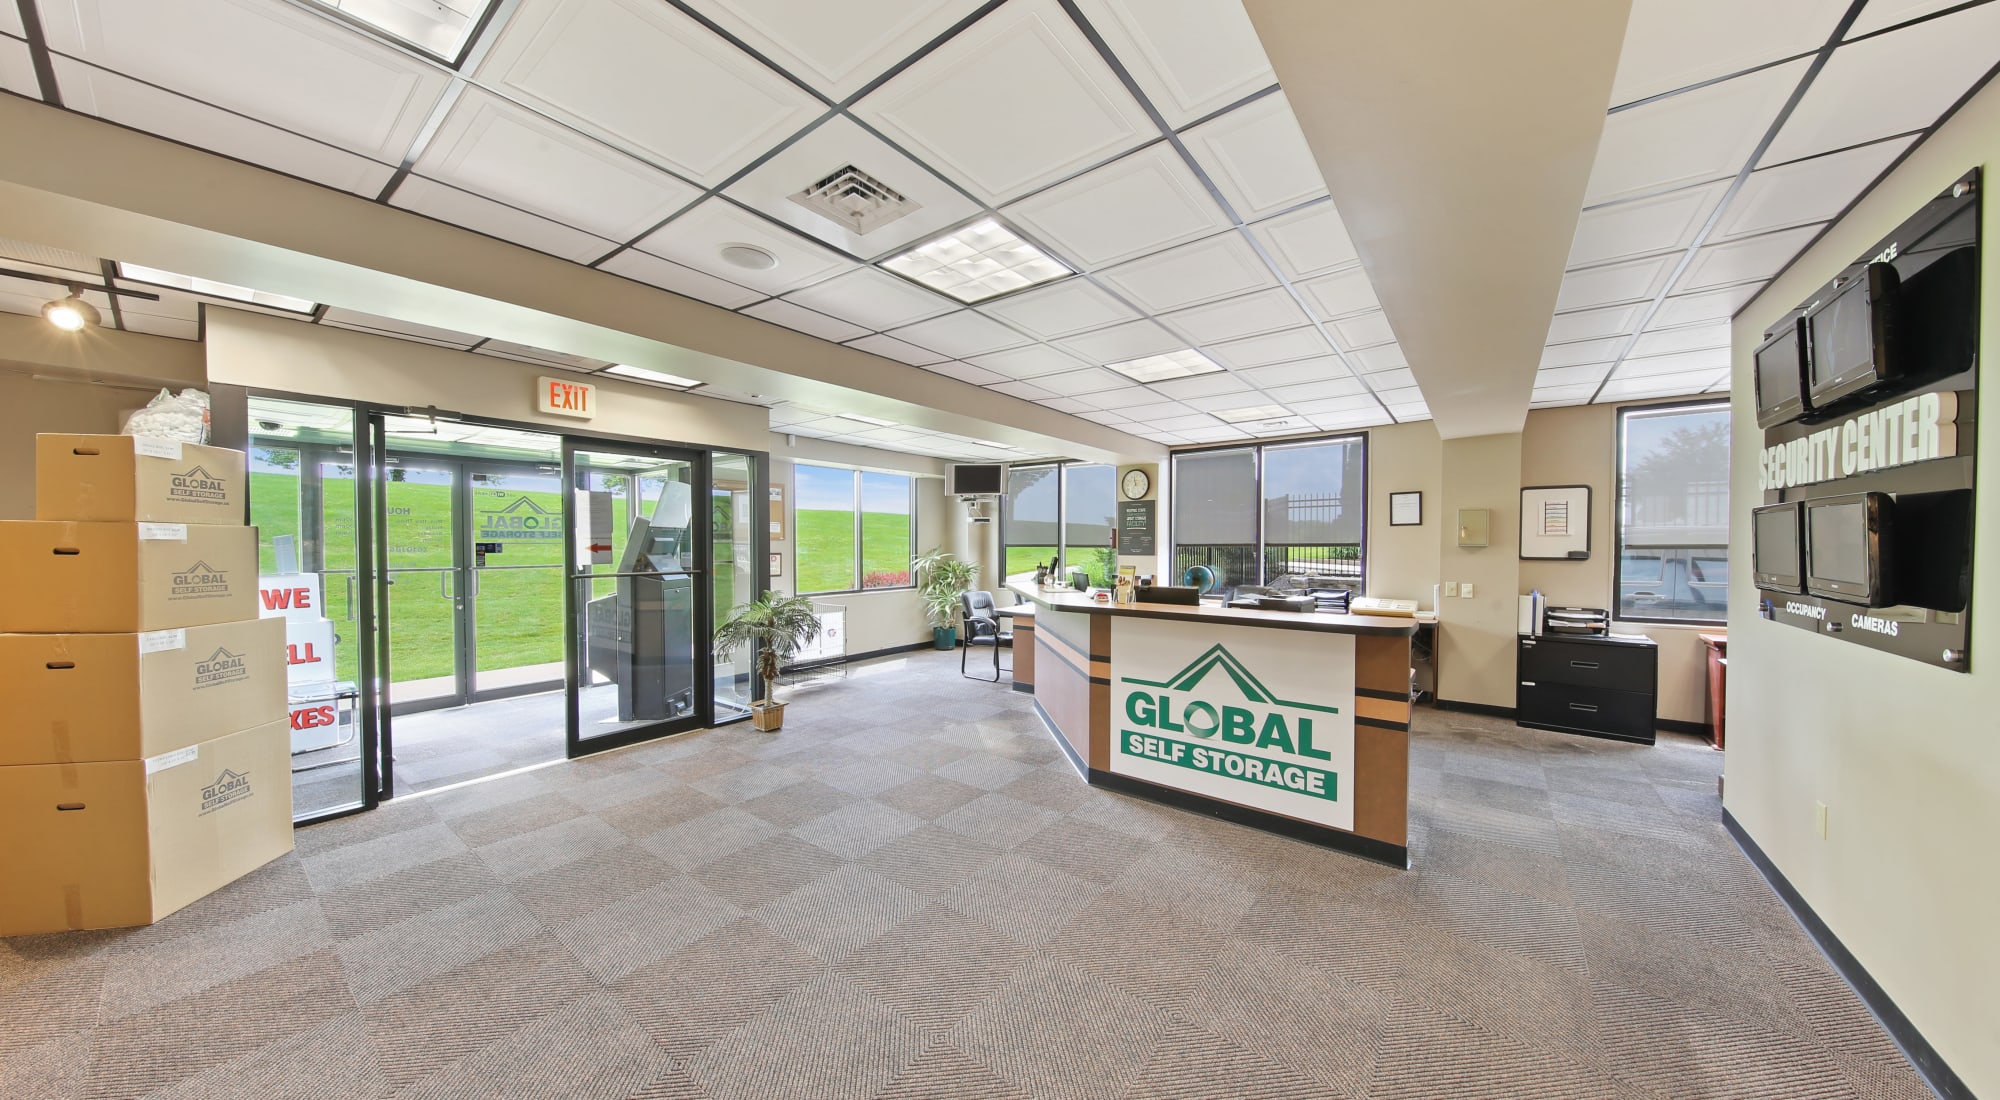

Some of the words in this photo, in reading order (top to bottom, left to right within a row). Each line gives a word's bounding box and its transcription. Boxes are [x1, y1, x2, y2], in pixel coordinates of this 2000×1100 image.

[550, 381, 589, 411] EXIT
[1759, 425, 1841, 491] SECURITY
[1842, 392, 1943, 475] CENTER
[172, 477, 225, 491] GLOBAL
[192, 491, 225, 499] STORAGE
[173, 574, 227, 586] GLOBAL
[174, 586, 193, 594] SELF
[195, 585, 226, 593] STORAGE
[260, 587, 310, 610] WE
[1786, 601, 1826, 620] OCCUPANCY
[1851, 613, 1898, 637] CAMERAS
[286, 642, 321, 665] LL
[196, 658, 245, 675] GLOBAL
[215, 668, 244, 680] STORAGE
[290, 705, 335, 730] XES
[1125, 691, 1331, 761] GLOBAL
[1129, 734, 1185, 762] SELF
[1192, 747, 1326, 795] STORAGE
[202, 776, 249, 801] GLOBAL
[219, 786, 248, 803] STORAGE
